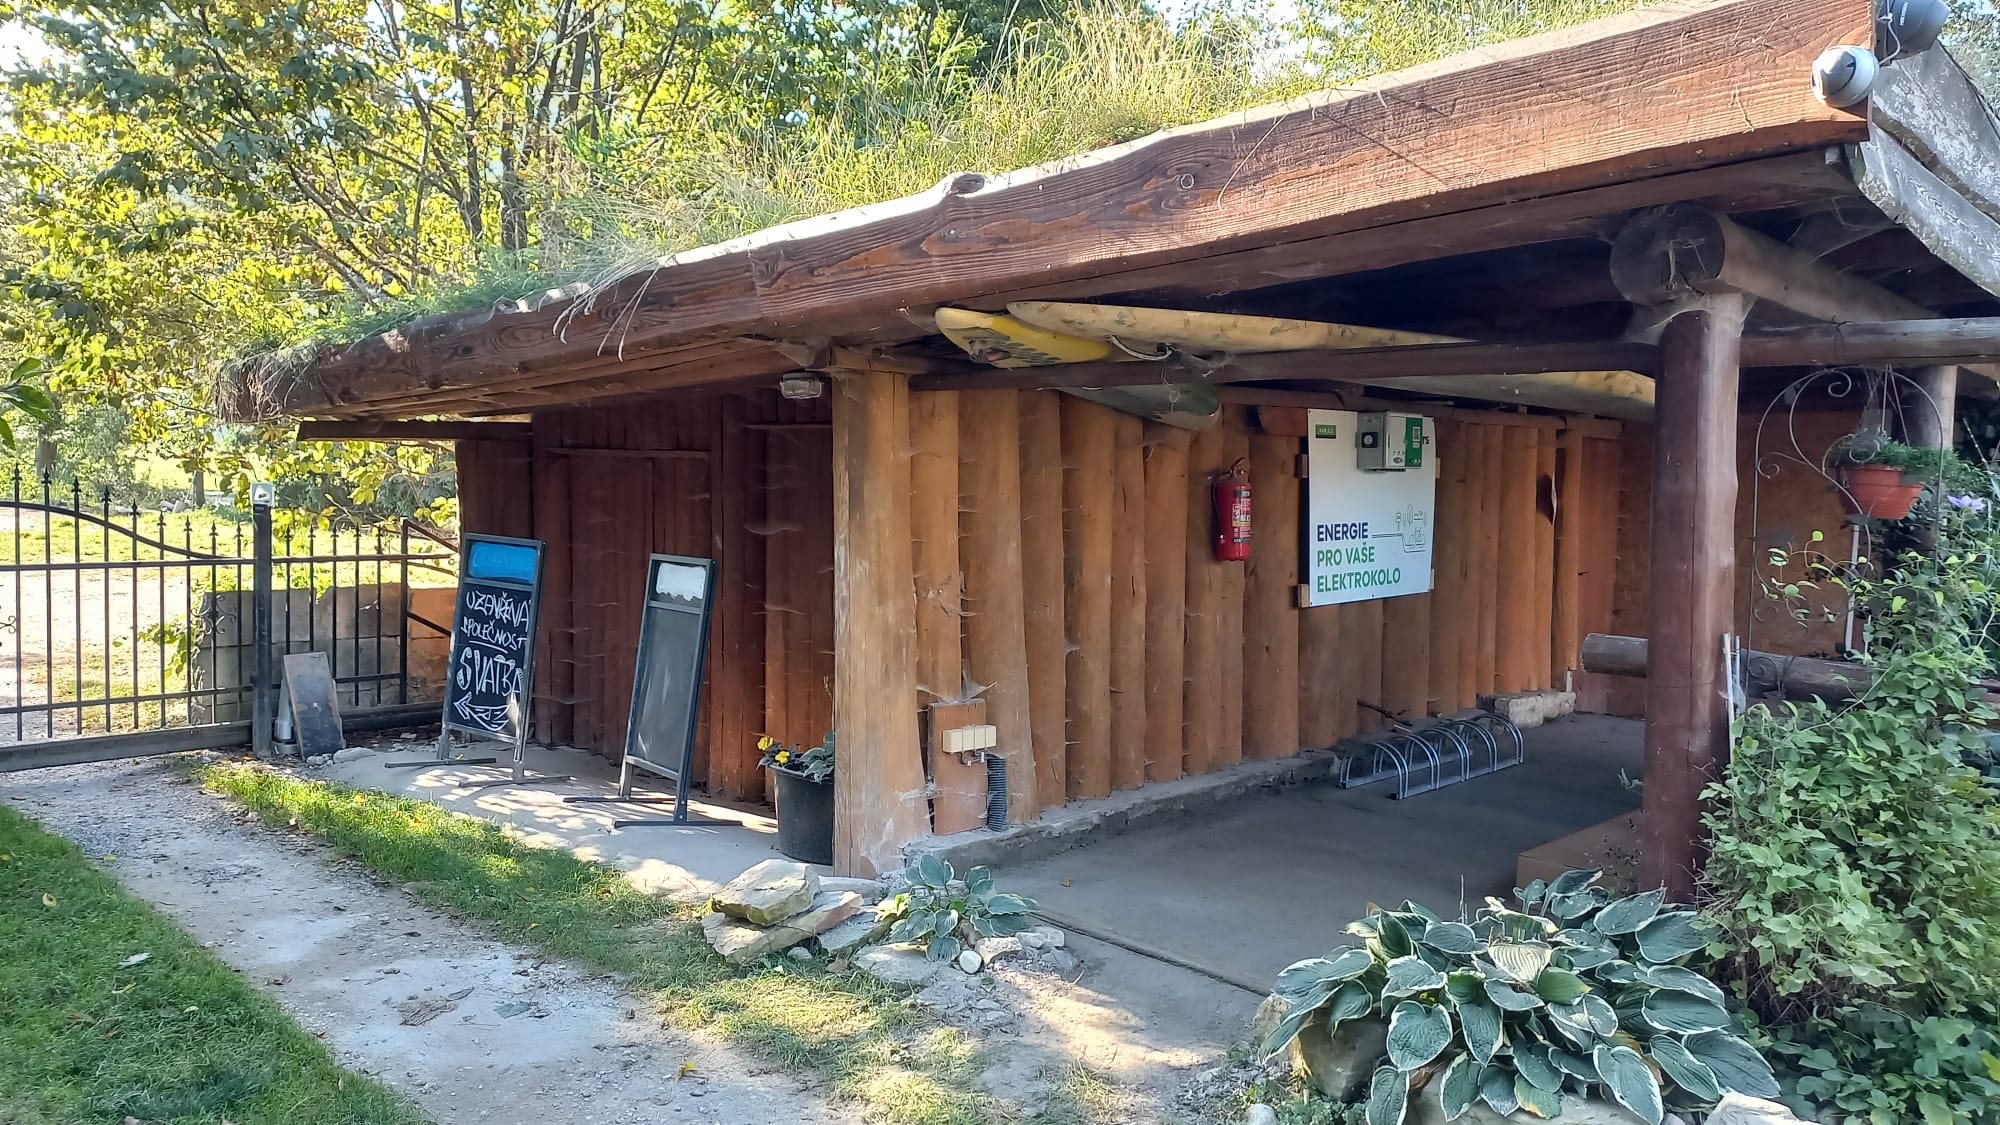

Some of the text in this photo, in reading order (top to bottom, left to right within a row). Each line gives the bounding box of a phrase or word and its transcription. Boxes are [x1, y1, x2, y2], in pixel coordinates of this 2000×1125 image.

[1317, 522, 1368, 542] ENERGIE
[1317, 542, 1375, 567] PRO VAŠE
[1317, 568, 1401, 593] ELEKTROKOLO
[460, 616, 528, 650] SPOLEČNOST
[456, 647, 523, 697] SVATBA
